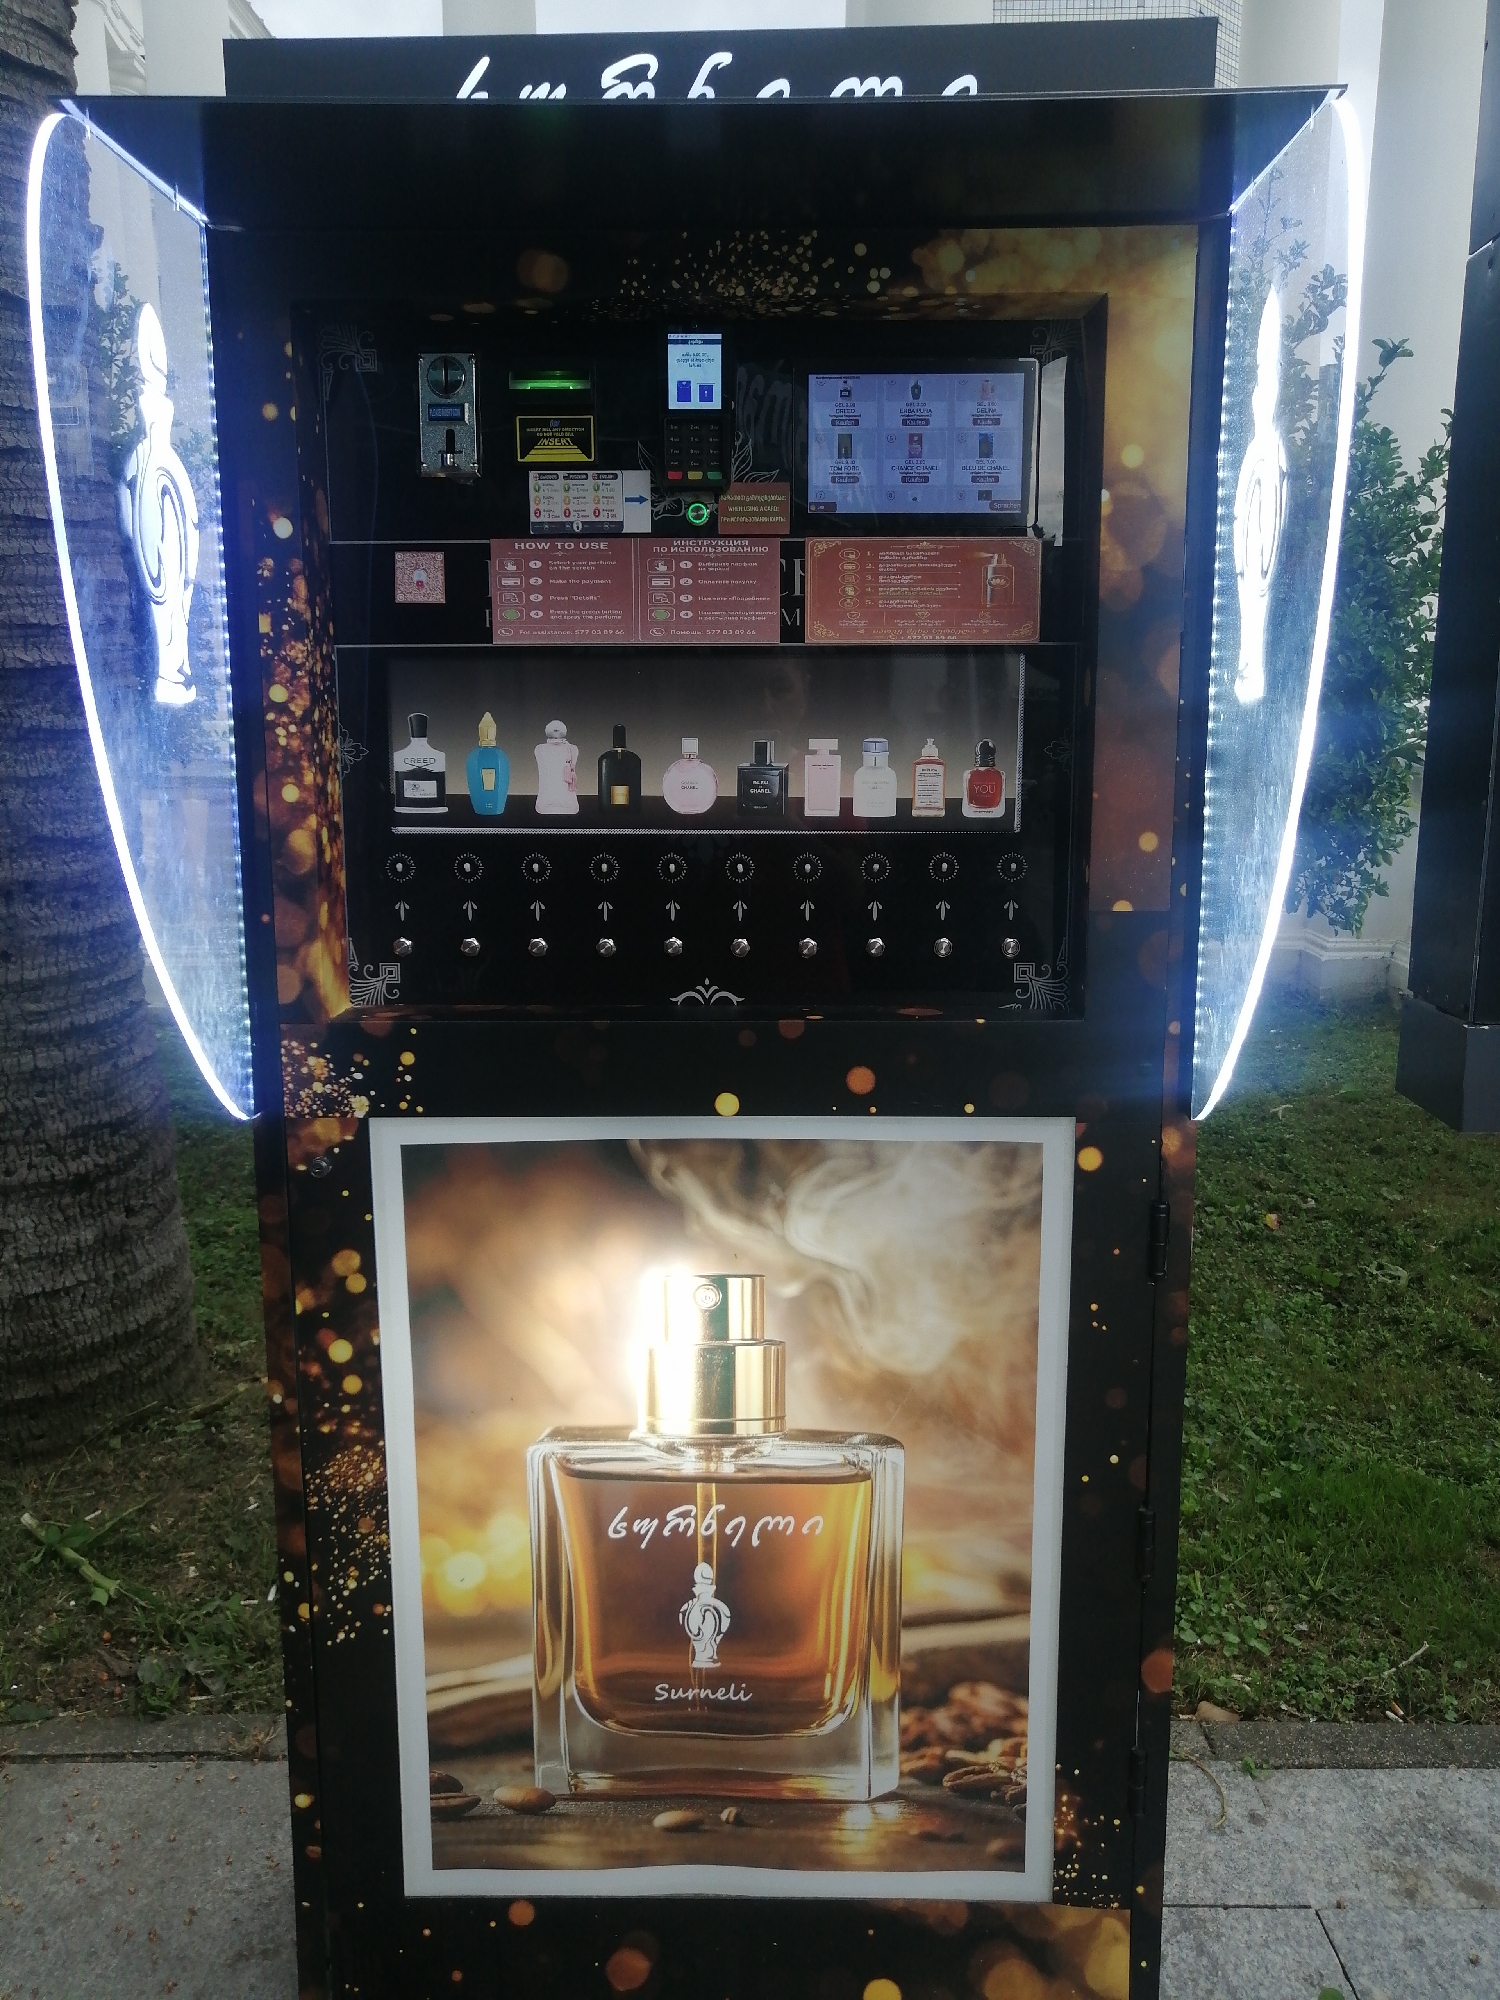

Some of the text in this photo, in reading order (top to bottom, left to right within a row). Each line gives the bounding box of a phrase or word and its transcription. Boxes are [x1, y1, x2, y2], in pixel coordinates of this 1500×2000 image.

[537, 438, 574, 446] INSERT
[514, 542, 609, 550] HOW TO USE
[673, 539, 749, 547] ИНСТРУКЦИЯ
[670, 546, 769, 554] ИСПОЛЬЗОВАНИЮ
[403, 757, 436, 765] CREED
[973, 784, 996, 794] YOU
[607, 1503, 824, 1550] სურნელი
[654, 1682, 753, 1702] Surneli
